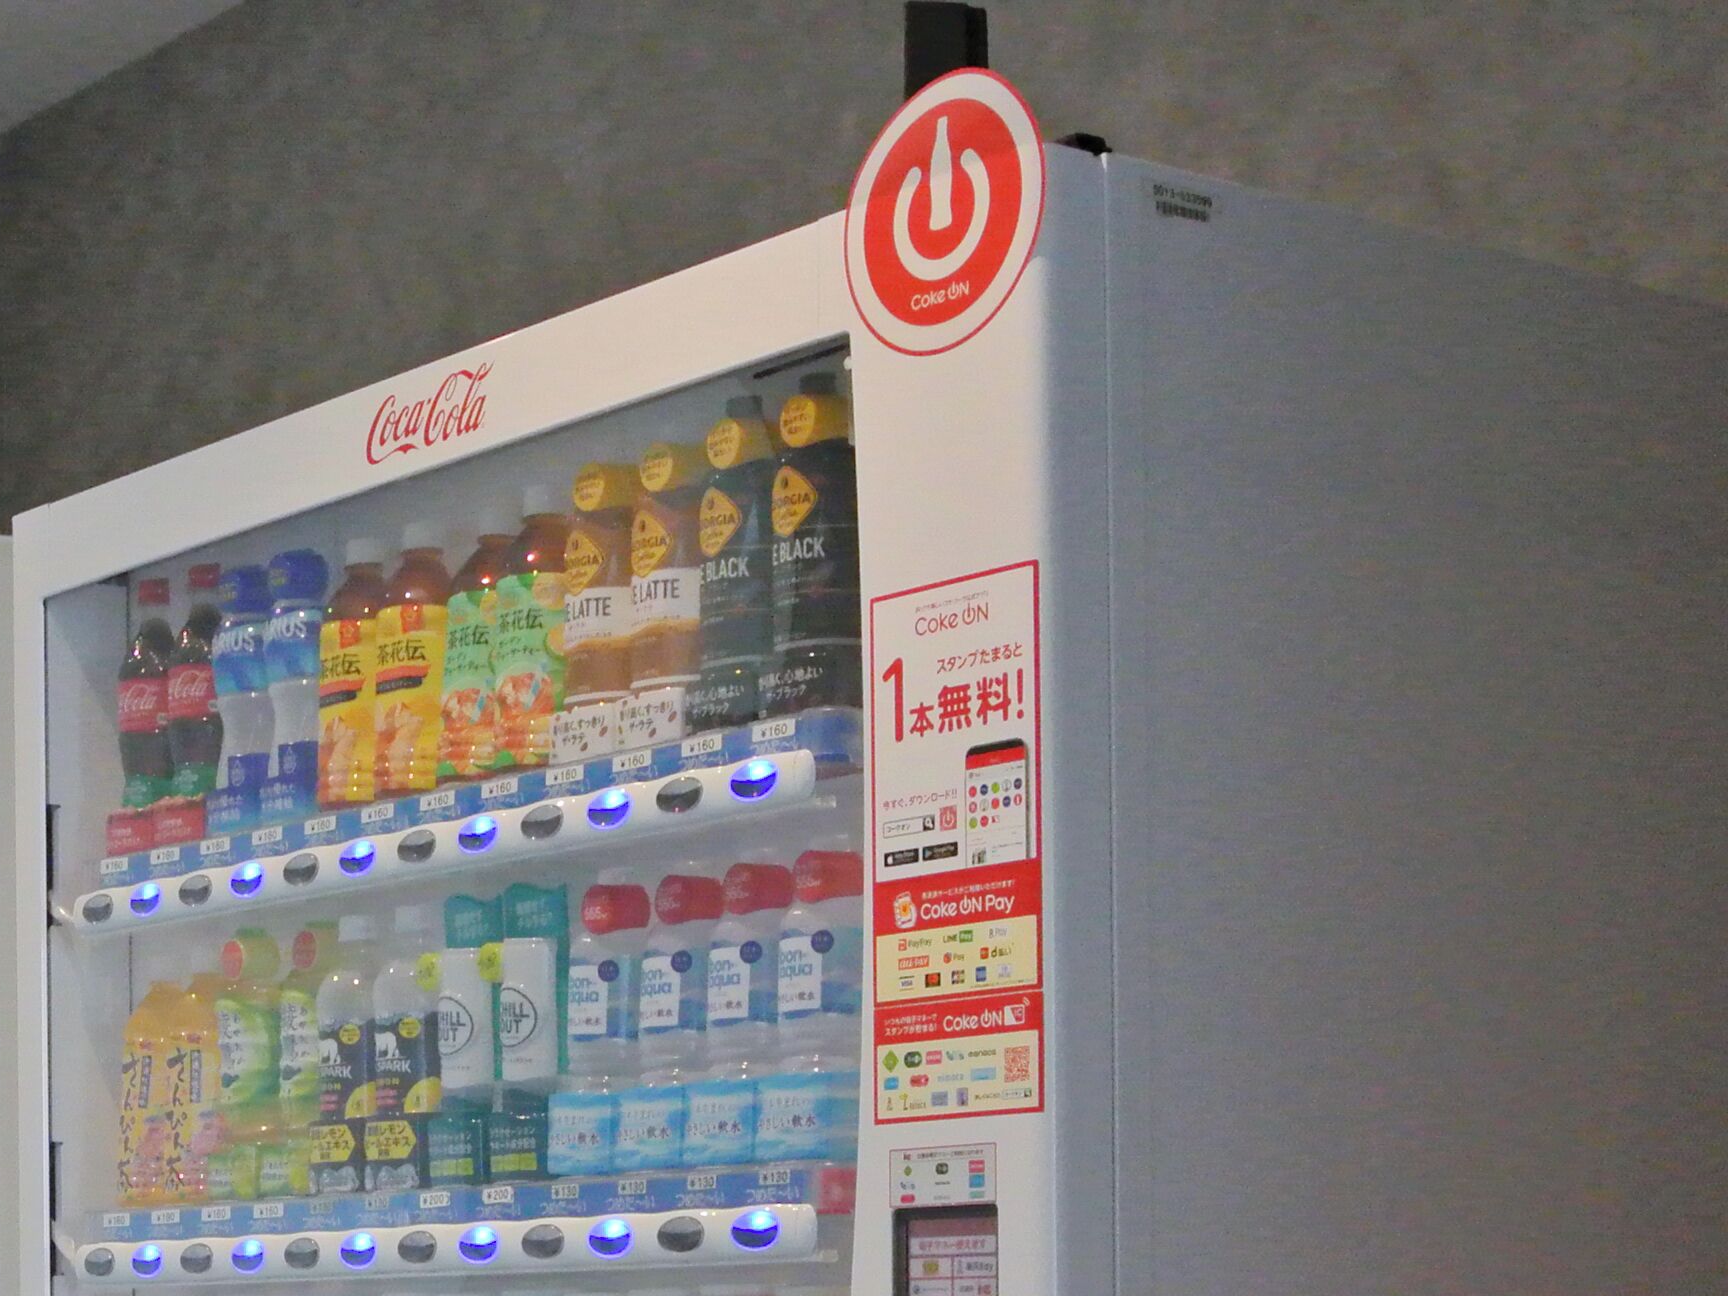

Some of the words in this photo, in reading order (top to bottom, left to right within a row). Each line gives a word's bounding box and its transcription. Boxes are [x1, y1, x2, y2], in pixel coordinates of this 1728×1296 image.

[911, 289, 946, 311] Coke
[947, 280, 970, 301] ON
[366, 361, 494, 465] Coca-Cola
[780, 536, 825, 564] BLACK
[705, 556, 750, 584] BLACK
[638, 578, 680, 603] LATTE
[572, 597, 612, 620] LATTE
[915, 612, 958, 636] Coke
[961, 602, 989, 625] ON
[498, 608, 544, 634] 茶花伝
[448, 624, 489, 651] 茶花伝
[377, 640, 426, 666] 茶花伝
[936, 642, 1023, 674] スタンプたまると
[761, 723, 788, 738] ¥160
[689, 739, 715, 753] ¥160
[620, 754, 645, 768] ¥160
[552, 768, 577, 781] ¥160
[488, 782, 512, 795] ¥160
[920, 902, 958, 920] Coke
[959, 895, 983, 915] ON
[985, 894, 1015, 914] Pay
[943, 1015, 979, 1032] Coke
[980, 1008, 1002, 1027] ON
[620, 1181, 645, 1193] ¥130
[689, 1176, 715, 1188] ¥130
[761, 1171, 789, 1184] ¥130
[423, 1193, 445, 1205] ¥200
[487, 1188, 508, 1200] ¥200
[554, 1186, 577, 1198] ¥130
